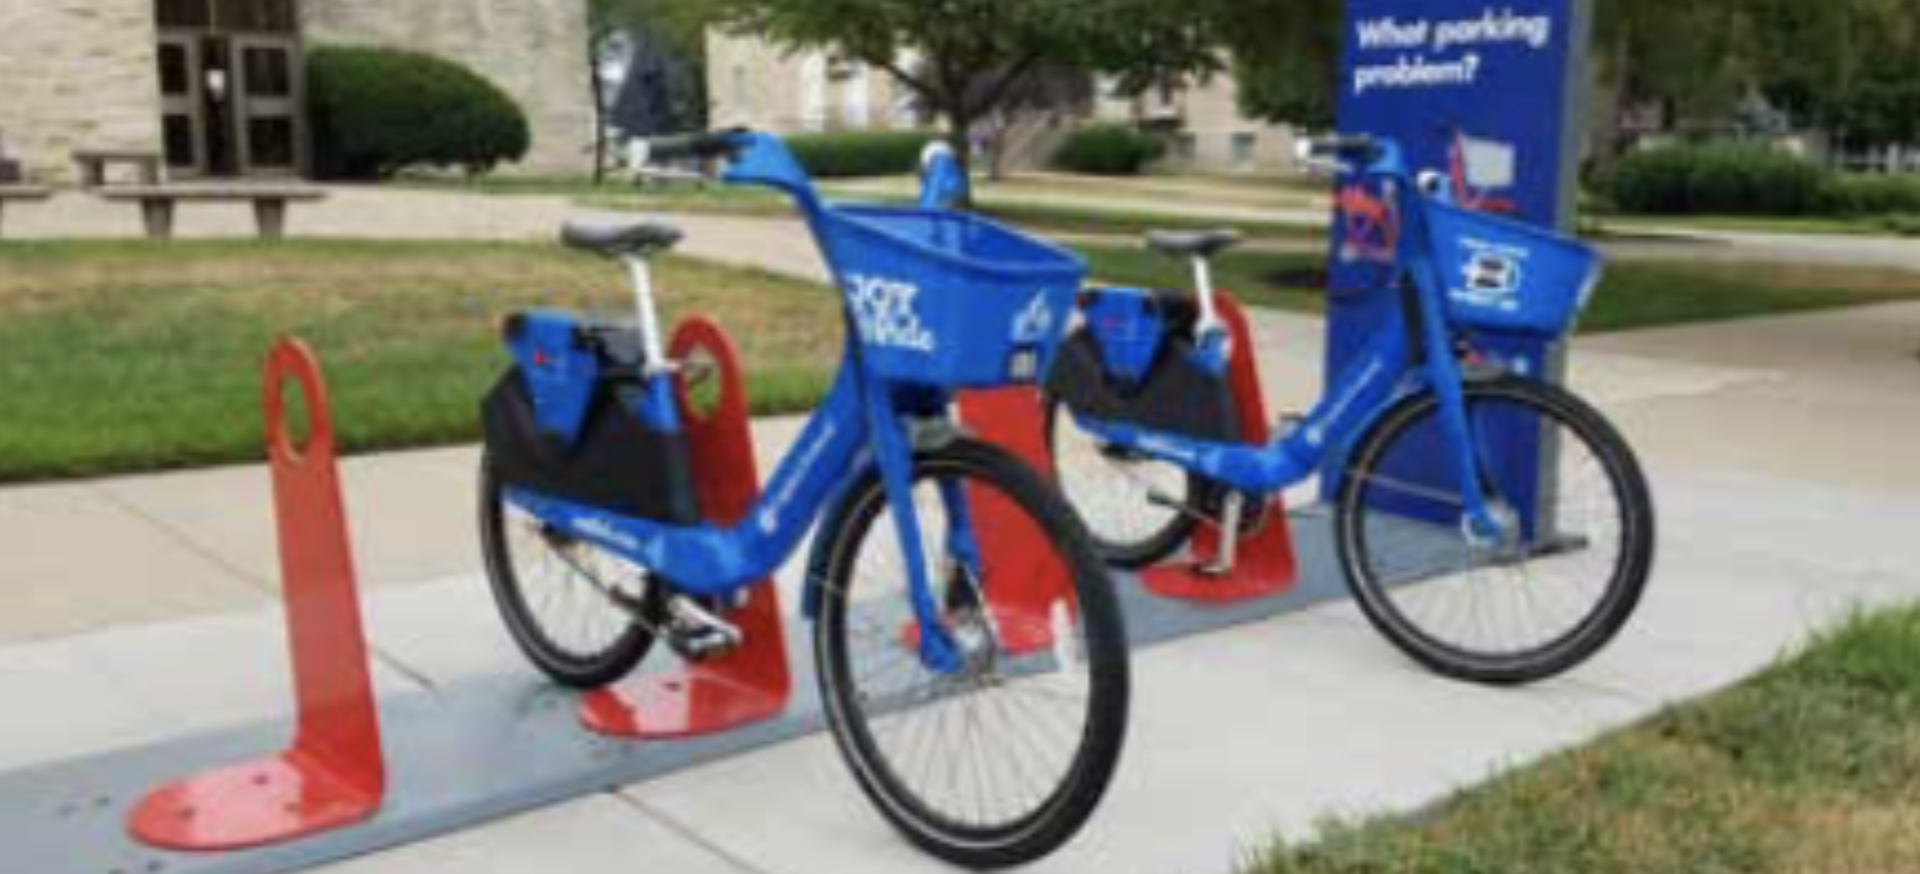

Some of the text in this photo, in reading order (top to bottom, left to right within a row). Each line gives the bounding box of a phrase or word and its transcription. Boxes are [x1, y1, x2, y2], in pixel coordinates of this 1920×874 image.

[1356, 8, 1549, 51] What parking
[1354, 54, 1480, 95] problem?
